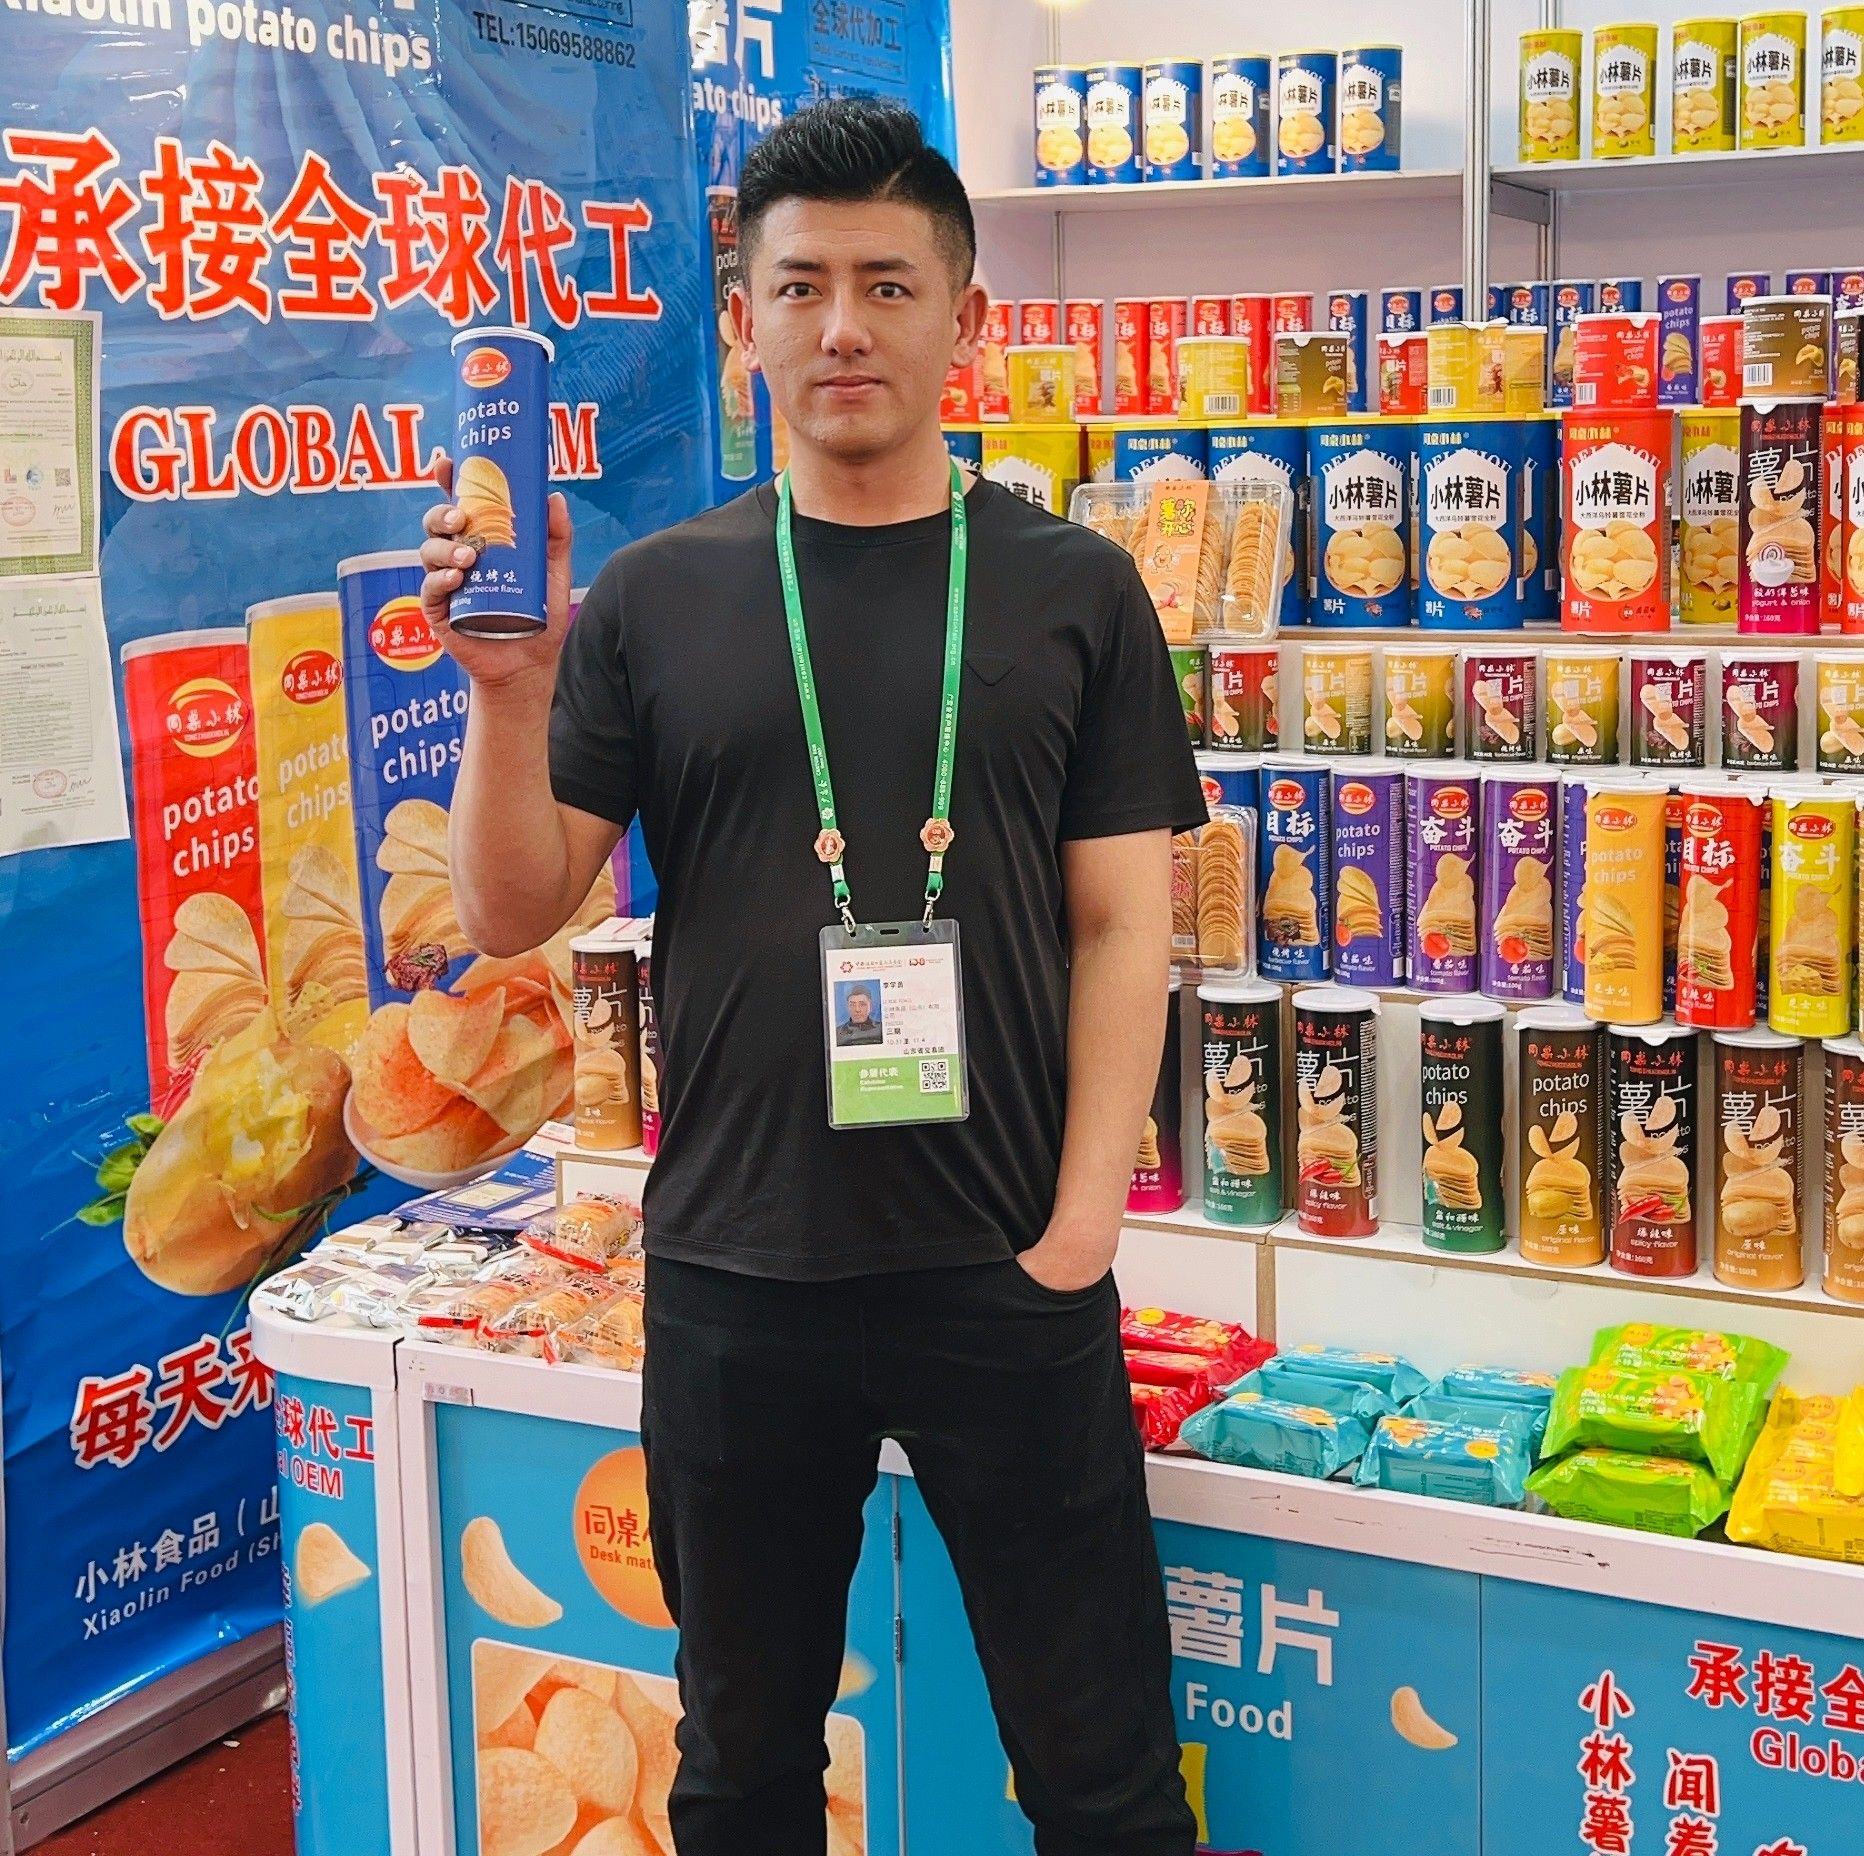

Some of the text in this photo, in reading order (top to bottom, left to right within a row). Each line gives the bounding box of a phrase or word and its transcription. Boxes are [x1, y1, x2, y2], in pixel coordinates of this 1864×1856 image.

[188, 0, 318, 54] potato
[326, 14, 432, 77] chips
[472, 10, 637, 69] TEL:15069588862
[1600, 61, 1642, 84] 小林薯片
[1748, 50, 1791, 74] 小林薯片
[1527, 67, 1570, 89] 小林薯片
[731, 84, 783, 128] chips
[0, 128, 662, 328] 承接全球代工
[1385, 313, 1415, 331] 目标
[1663, 306, 1694, 321] potato
[1665, 317, 1691, 331] chips
[458, 398, 520, 431] potato
[1751, 418, 1812, 434] 同桌小林
[460, 424, 512, 450] chips
[109, 403, 442, 500] GLOBAL
[1747, 440, 1819, 489] 薯片
[1329, 475, 1398, 510] 小林薯片
[1430, 474, 1501, 510] 小林薯片
[1575, 470, 1650, 507] 小林薯片
[470, 568, 518, 583] 烧烤味
[501, 584, 524, 595] flavor
[1753, 587, 1810, 598] 酸奶洋葱味
[1323, 598, 1346, 615] 薯片
[1425, 600, 1446, 617] 薯片
[1570, 600, 1592, 618] 薯片
[1752, 598, 1778, 608] yogurt
[284, 660, 342, 692] 同桌小林
[166, 700, 244, 734] 同桌小林
[371, 688, 469, 749] potato
[382, 736, 461, 785] chips
[286, 780, 351, 829] chips
[1267, 810, 1316, 837] 目标
[1335, 824, 1381, 841] potato
[1420, 815, 1475, 846] 奋斗
[1497, 818, 1554, 848] 奋斗
[1788, 820, 1834, 834] 同桌小林
[173, 824, 256, 879] chips
[1337, 842, 1375, 860] chips
[1507, 847, 1547, 855] POTATO CHIPS
[1591, 845, 1642, 864] potato
[1683, 837, 1736, 870] 目标
[1779, 842, 1840, 875] 奋斗
[1594, 867, 1636, 885] chips
[573, 981, 628, 1024] 薯片
[1204, 1012, 1259, 1030] 同桌小林
[1297, 1021, 1349, 1037] 同桌小林
[1203, 1036, 1269, 1081] 薯片
[1528, 1043, 1591, 1061] 同桌小林
[1620, 1049, 1685, 1067] 同桌小林
[1296, 1046, 1360, 1092] 薯片
[1422, 1063, 1471, 1082] potato
[1723, 1058, 1789, 1075] 同桌小林
[1532, 1073, 1590, 1095] potato
[1425, 1087, 1468, 1105] chips
[1539, 1098, 1588, 1117] chips
[1617, 1075, 1692, 1127] 薯片
[1720, 1085, 1797, 1136] 薯片
[1541, 1235, 1594, 1244] original flavor
[1556, 1224, 1580, 1235] 原味
[1630, 1238, 1678, 1250] spicy flavor
[1726, 1250, 1783, 1260] original flavor
[1741, 1240, 1766, 1251] 原味
[276, 1393, 374, 1462] 球代工
[292, 1456, 344, 1500] OEM
[590, 1545, 622, 1563] Desk
[83, 1585, 170, 1640] Xiaolin
[180, 1551, 239, 1593] Food
[1164, 1566, 1340, 1687] 薯片
[1186, 1681, 1292, 1741] Food
